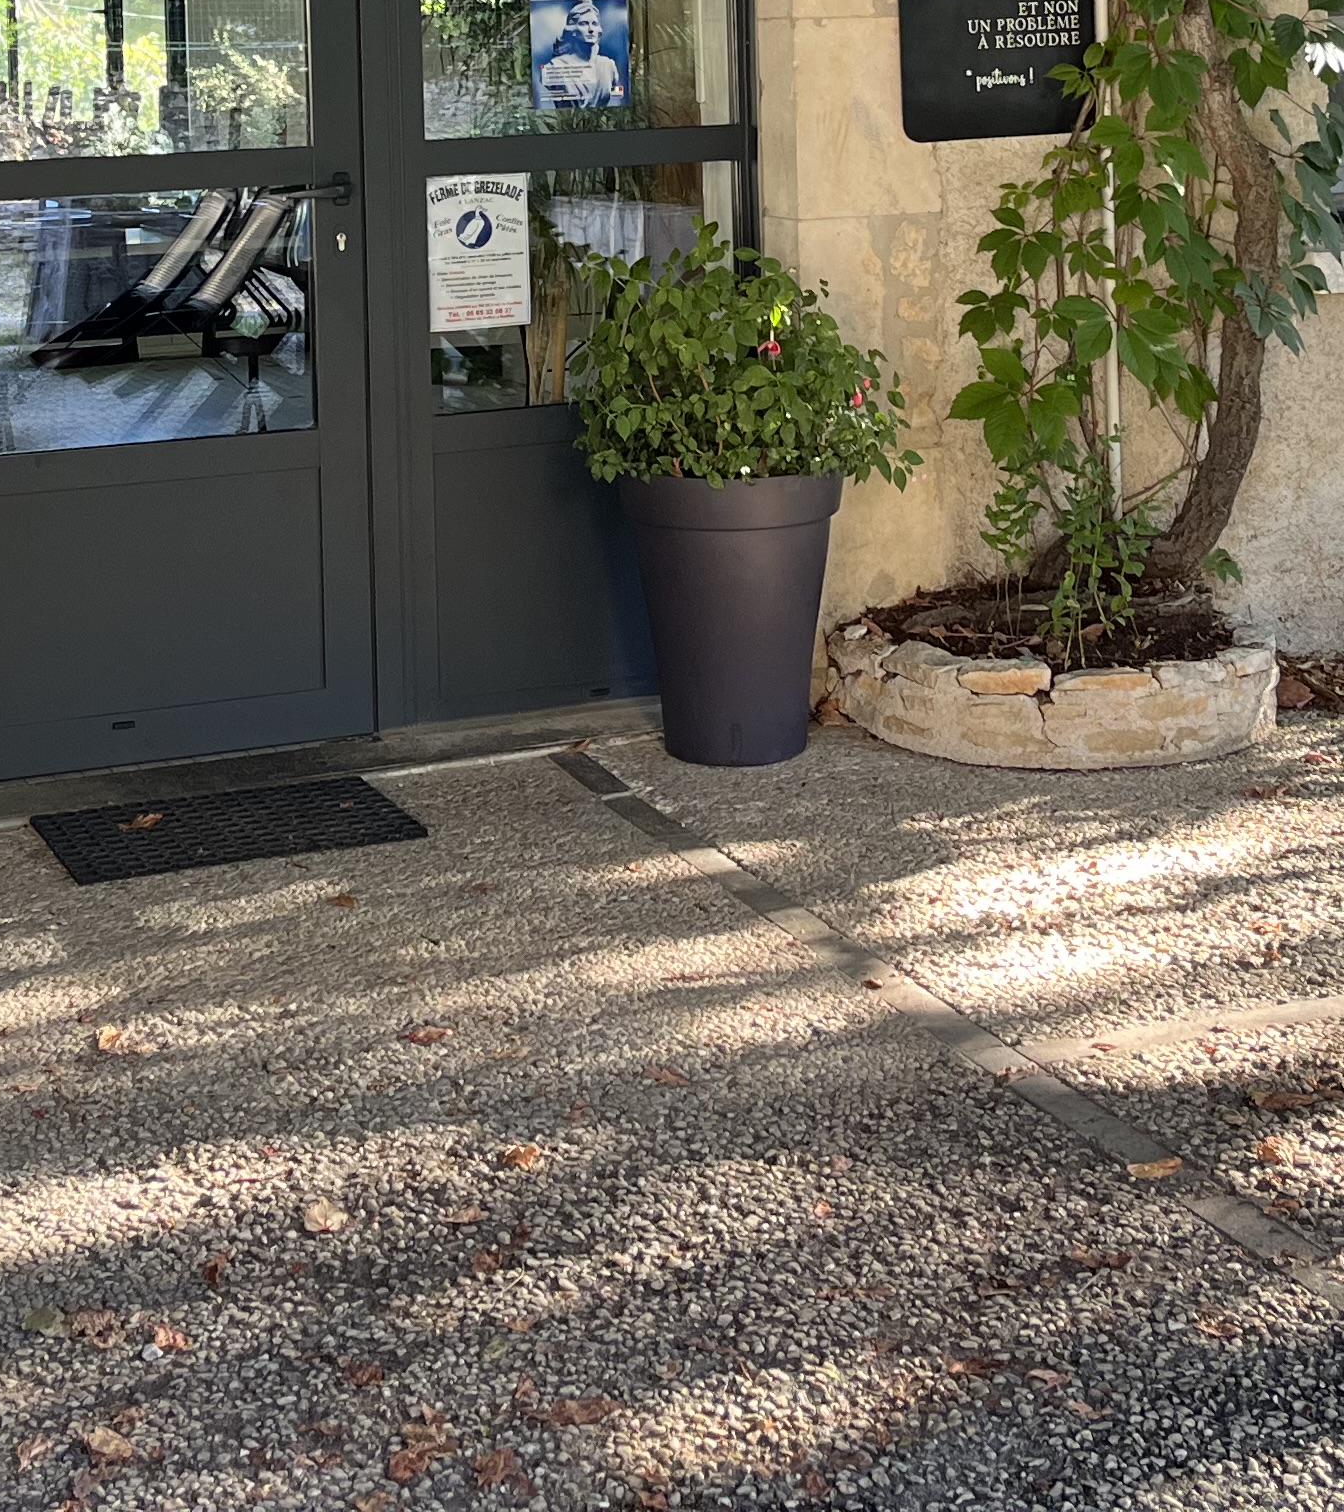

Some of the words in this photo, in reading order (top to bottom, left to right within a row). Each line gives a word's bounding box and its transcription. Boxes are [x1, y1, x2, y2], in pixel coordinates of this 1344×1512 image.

[1018, 1, 1039, 16] ET
[1044, 0, 1079, 14] NON
[967, 19, 992, 34] UN
[996, 13, 1081, 32] PROBLÈME
[977, 33, 989, 50] À
[994, 31, 1081, 49] RÉSOUDRE
[1029, 66, 1034, 84] !
[428, 183, 460, 205] FERME
